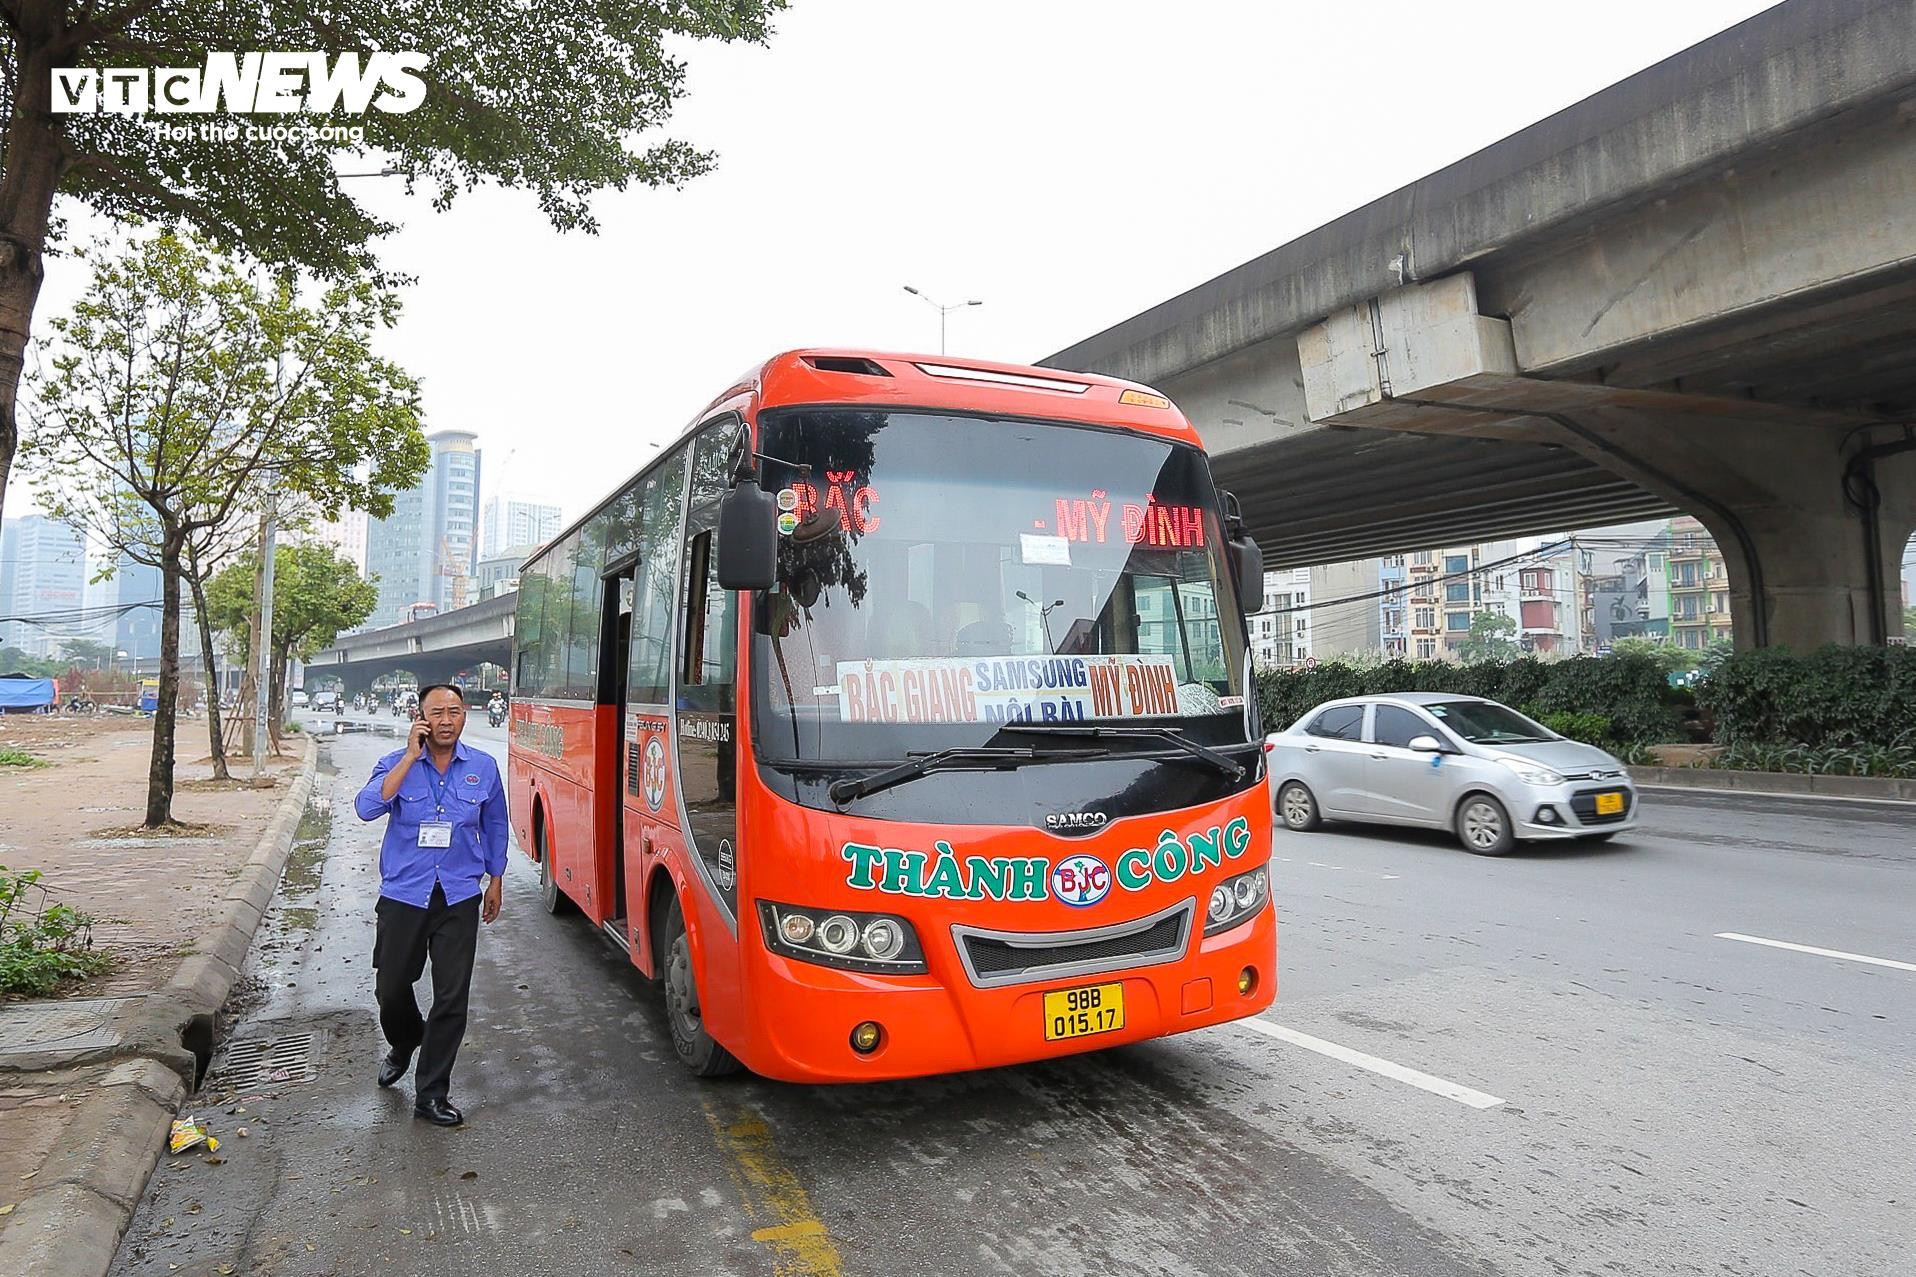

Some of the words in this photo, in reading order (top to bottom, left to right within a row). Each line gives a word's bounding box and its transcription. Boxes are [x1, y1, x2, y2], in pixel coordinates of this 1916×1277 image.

[1055, 489, 1111, 544] MỸ
[1121, 491, 1206, 547] ĐÌNH
[975, 657, 1087, 691] SAMSUNG
[1089, 657, 1122, 717] MỸ
[1126, 658, 1178, 715] ĐÌNH
[903, 667, 977, 722] GIANG
[1046, 812, 1107, 827] SAMCO
[842, 841, 1049, 902] THÀNH
[1116, 816, 1251, 892] CÔNG
[1060, 865, 1107, 893] BJC
[1067, 987, 1101, 1010] 98B
[1054, 1008, 1116, 1037] 015.17
